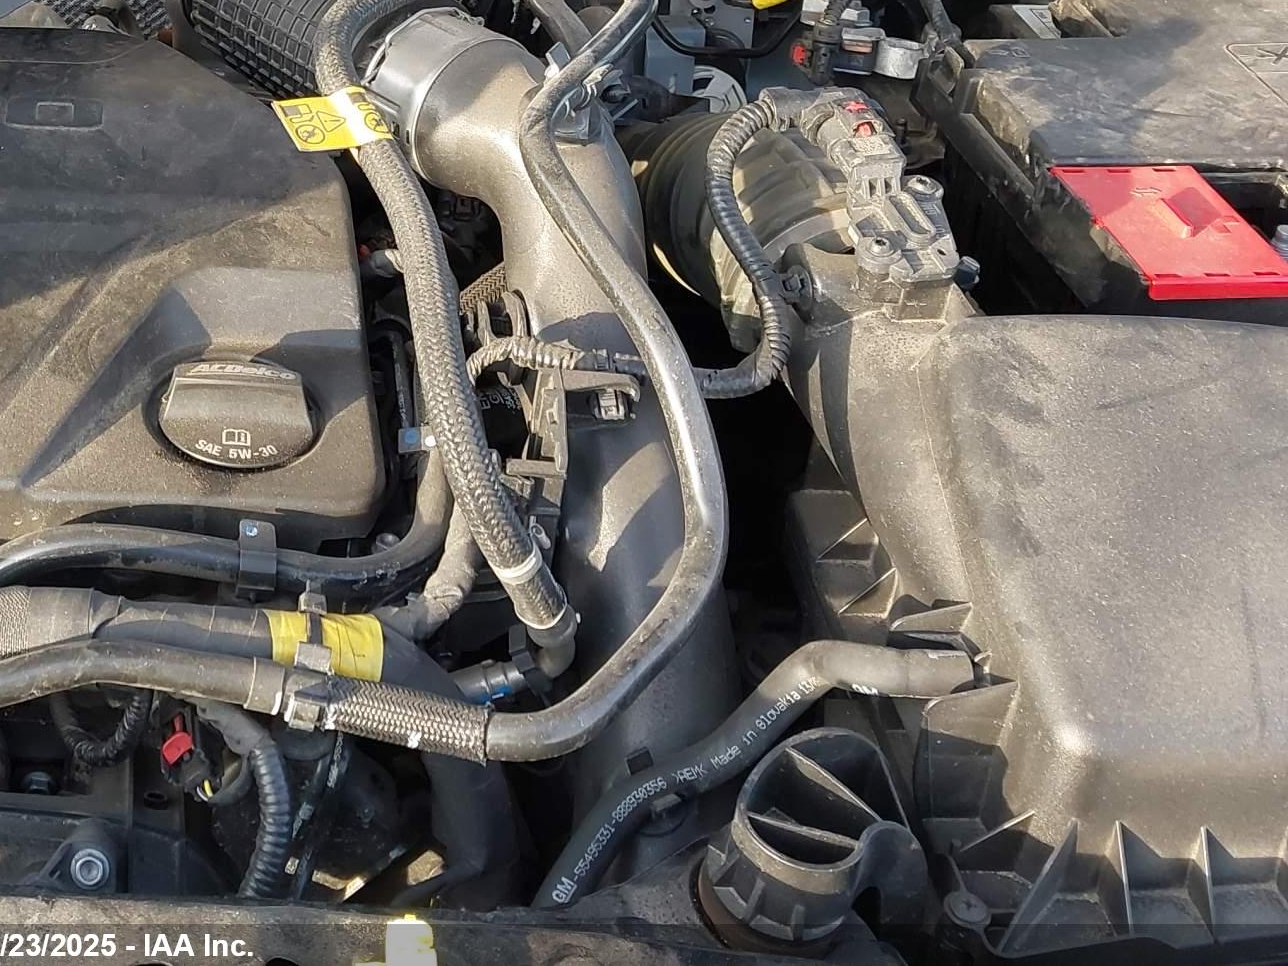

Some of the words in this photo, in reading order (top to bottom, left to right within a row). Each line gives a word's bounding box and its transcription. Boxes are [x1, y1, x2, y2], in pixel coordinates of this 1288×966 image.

[190, 363, 297, 380] ACDelco
[195, 441, 223, 458] SAE
[229, 445, 280, 461] 5W-30
[710, 744, 741, 770] Made
[742, 730, 758, 746] in
